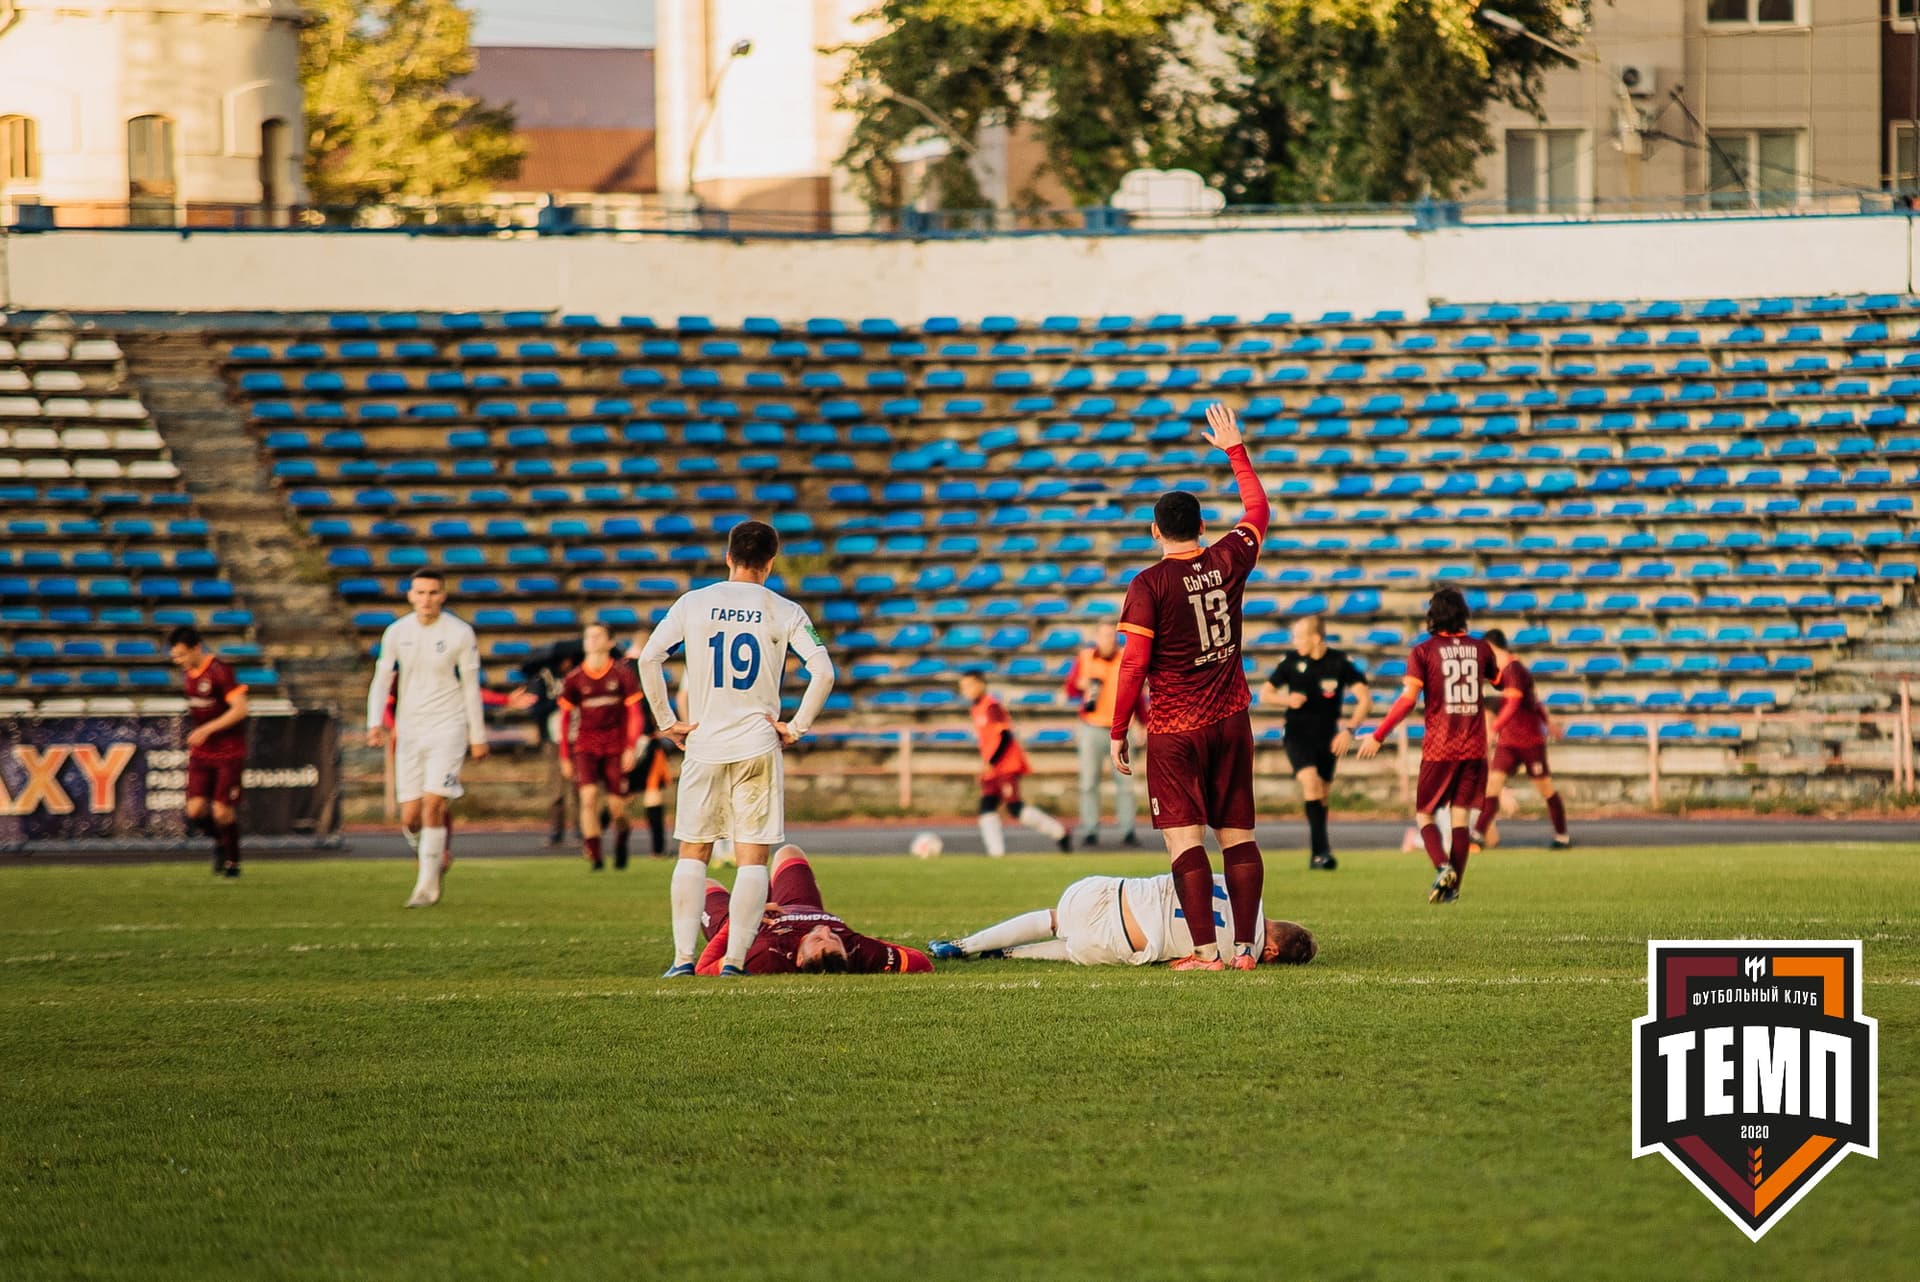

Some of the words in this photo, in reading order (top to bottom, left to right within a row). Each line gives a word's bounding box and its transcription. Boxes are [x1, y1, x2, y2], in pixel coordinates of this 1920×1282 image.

[711, 607, 762, 624] ГАРБУЗ
[1188, 588, 1231, 652] 13
[708, 631, 761, 690] 19
[1442, 659, 1479, 704] 23
